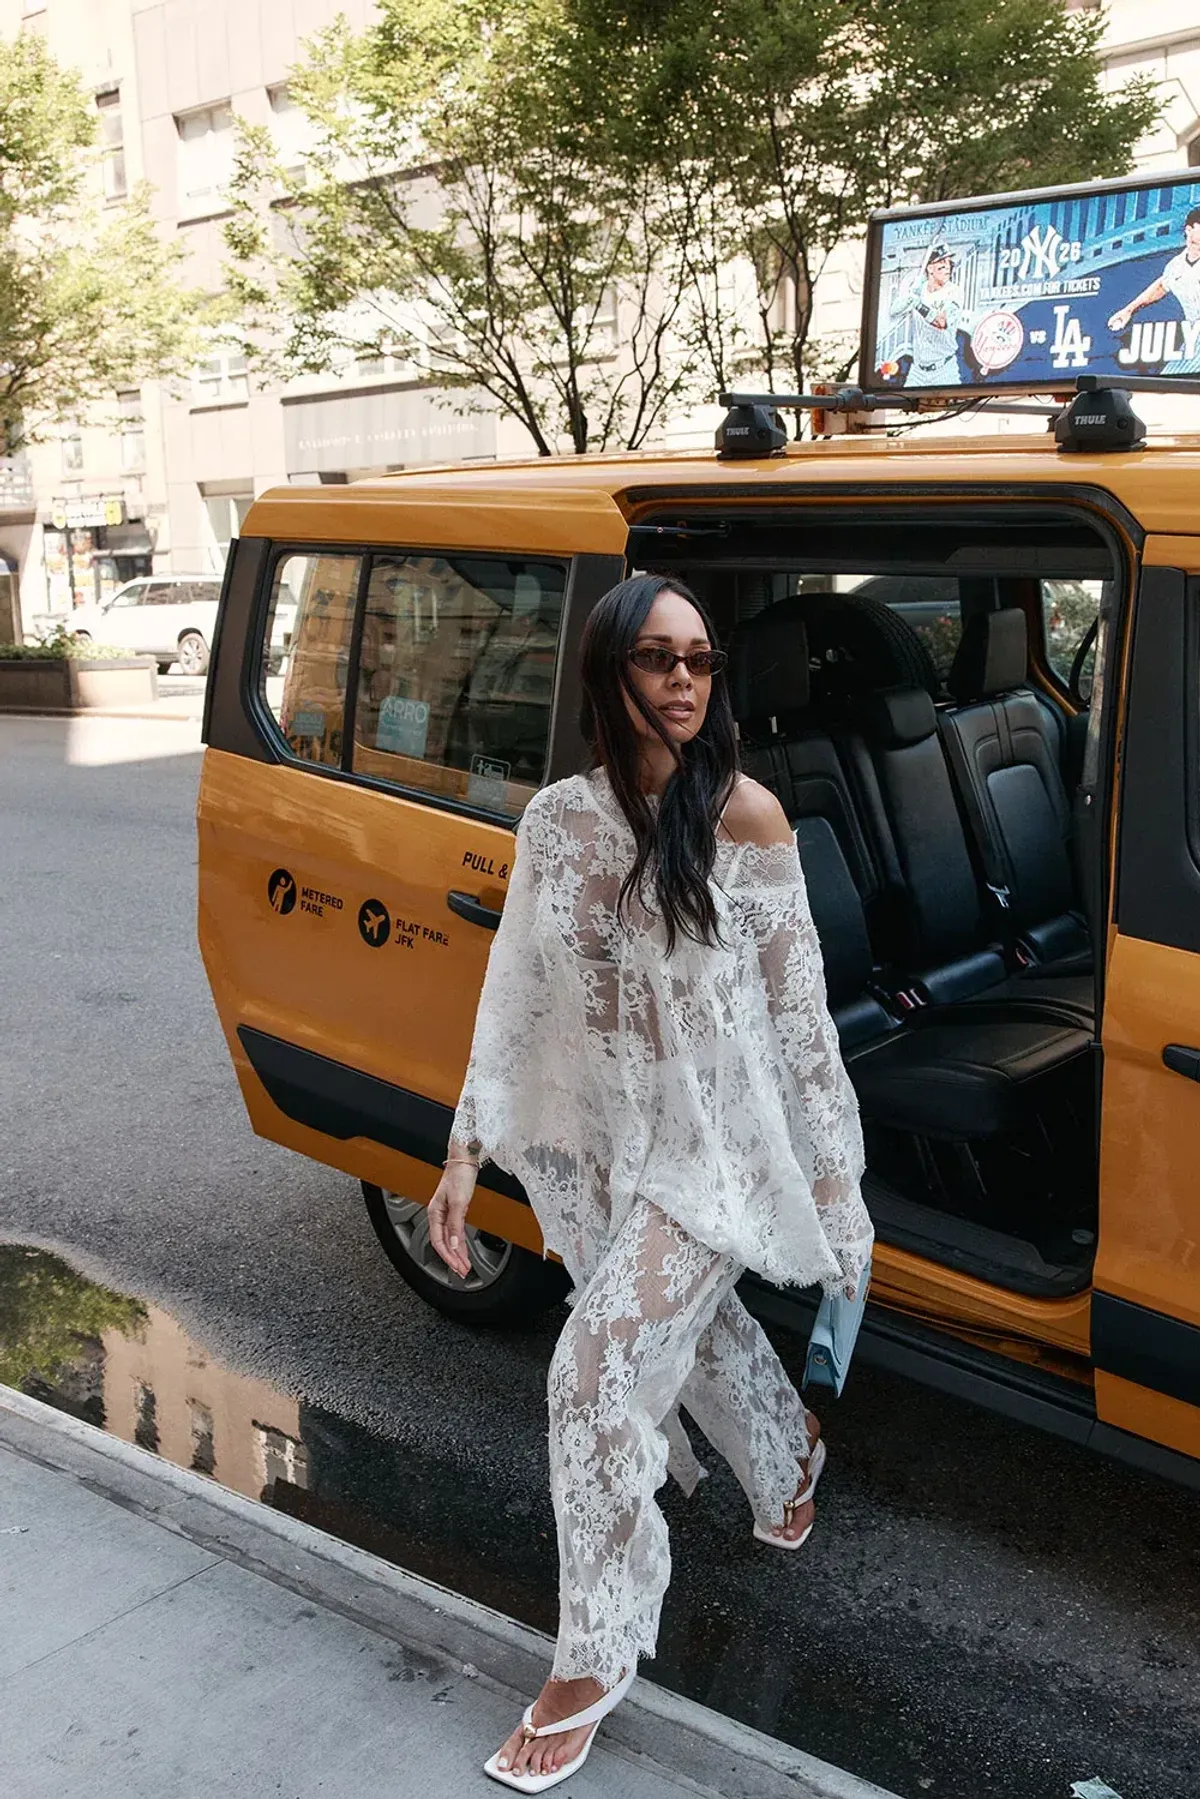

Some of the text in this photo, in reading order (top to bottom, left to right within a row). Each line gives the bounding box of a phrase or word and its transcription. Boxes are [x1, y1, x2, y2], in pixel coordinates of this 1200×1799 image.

[893, 216, 990, 239] YANKEE STADIUM
[1000, 225, 1081, 280] 20 NY 26
[1042, 279, 1061, 295] FOR
[1063, 276, 1101, 293] TICKETS
[1050, 305, 1091, 368] LA
[1118, 320, 1200, 364] JULY
[726, 427, 749, 436] THULE
[1074, 415, 1107, 425] THULE
[380, 696, 428, 724] ARRO
[462, 851, 508, 879] PULL &
[300, 901, 324, 917] FARE
[301, 887, 343, 910] METERED
[394, 933, 415, 949] JFK
[396, 918, 450, 946] FLAT FARE
